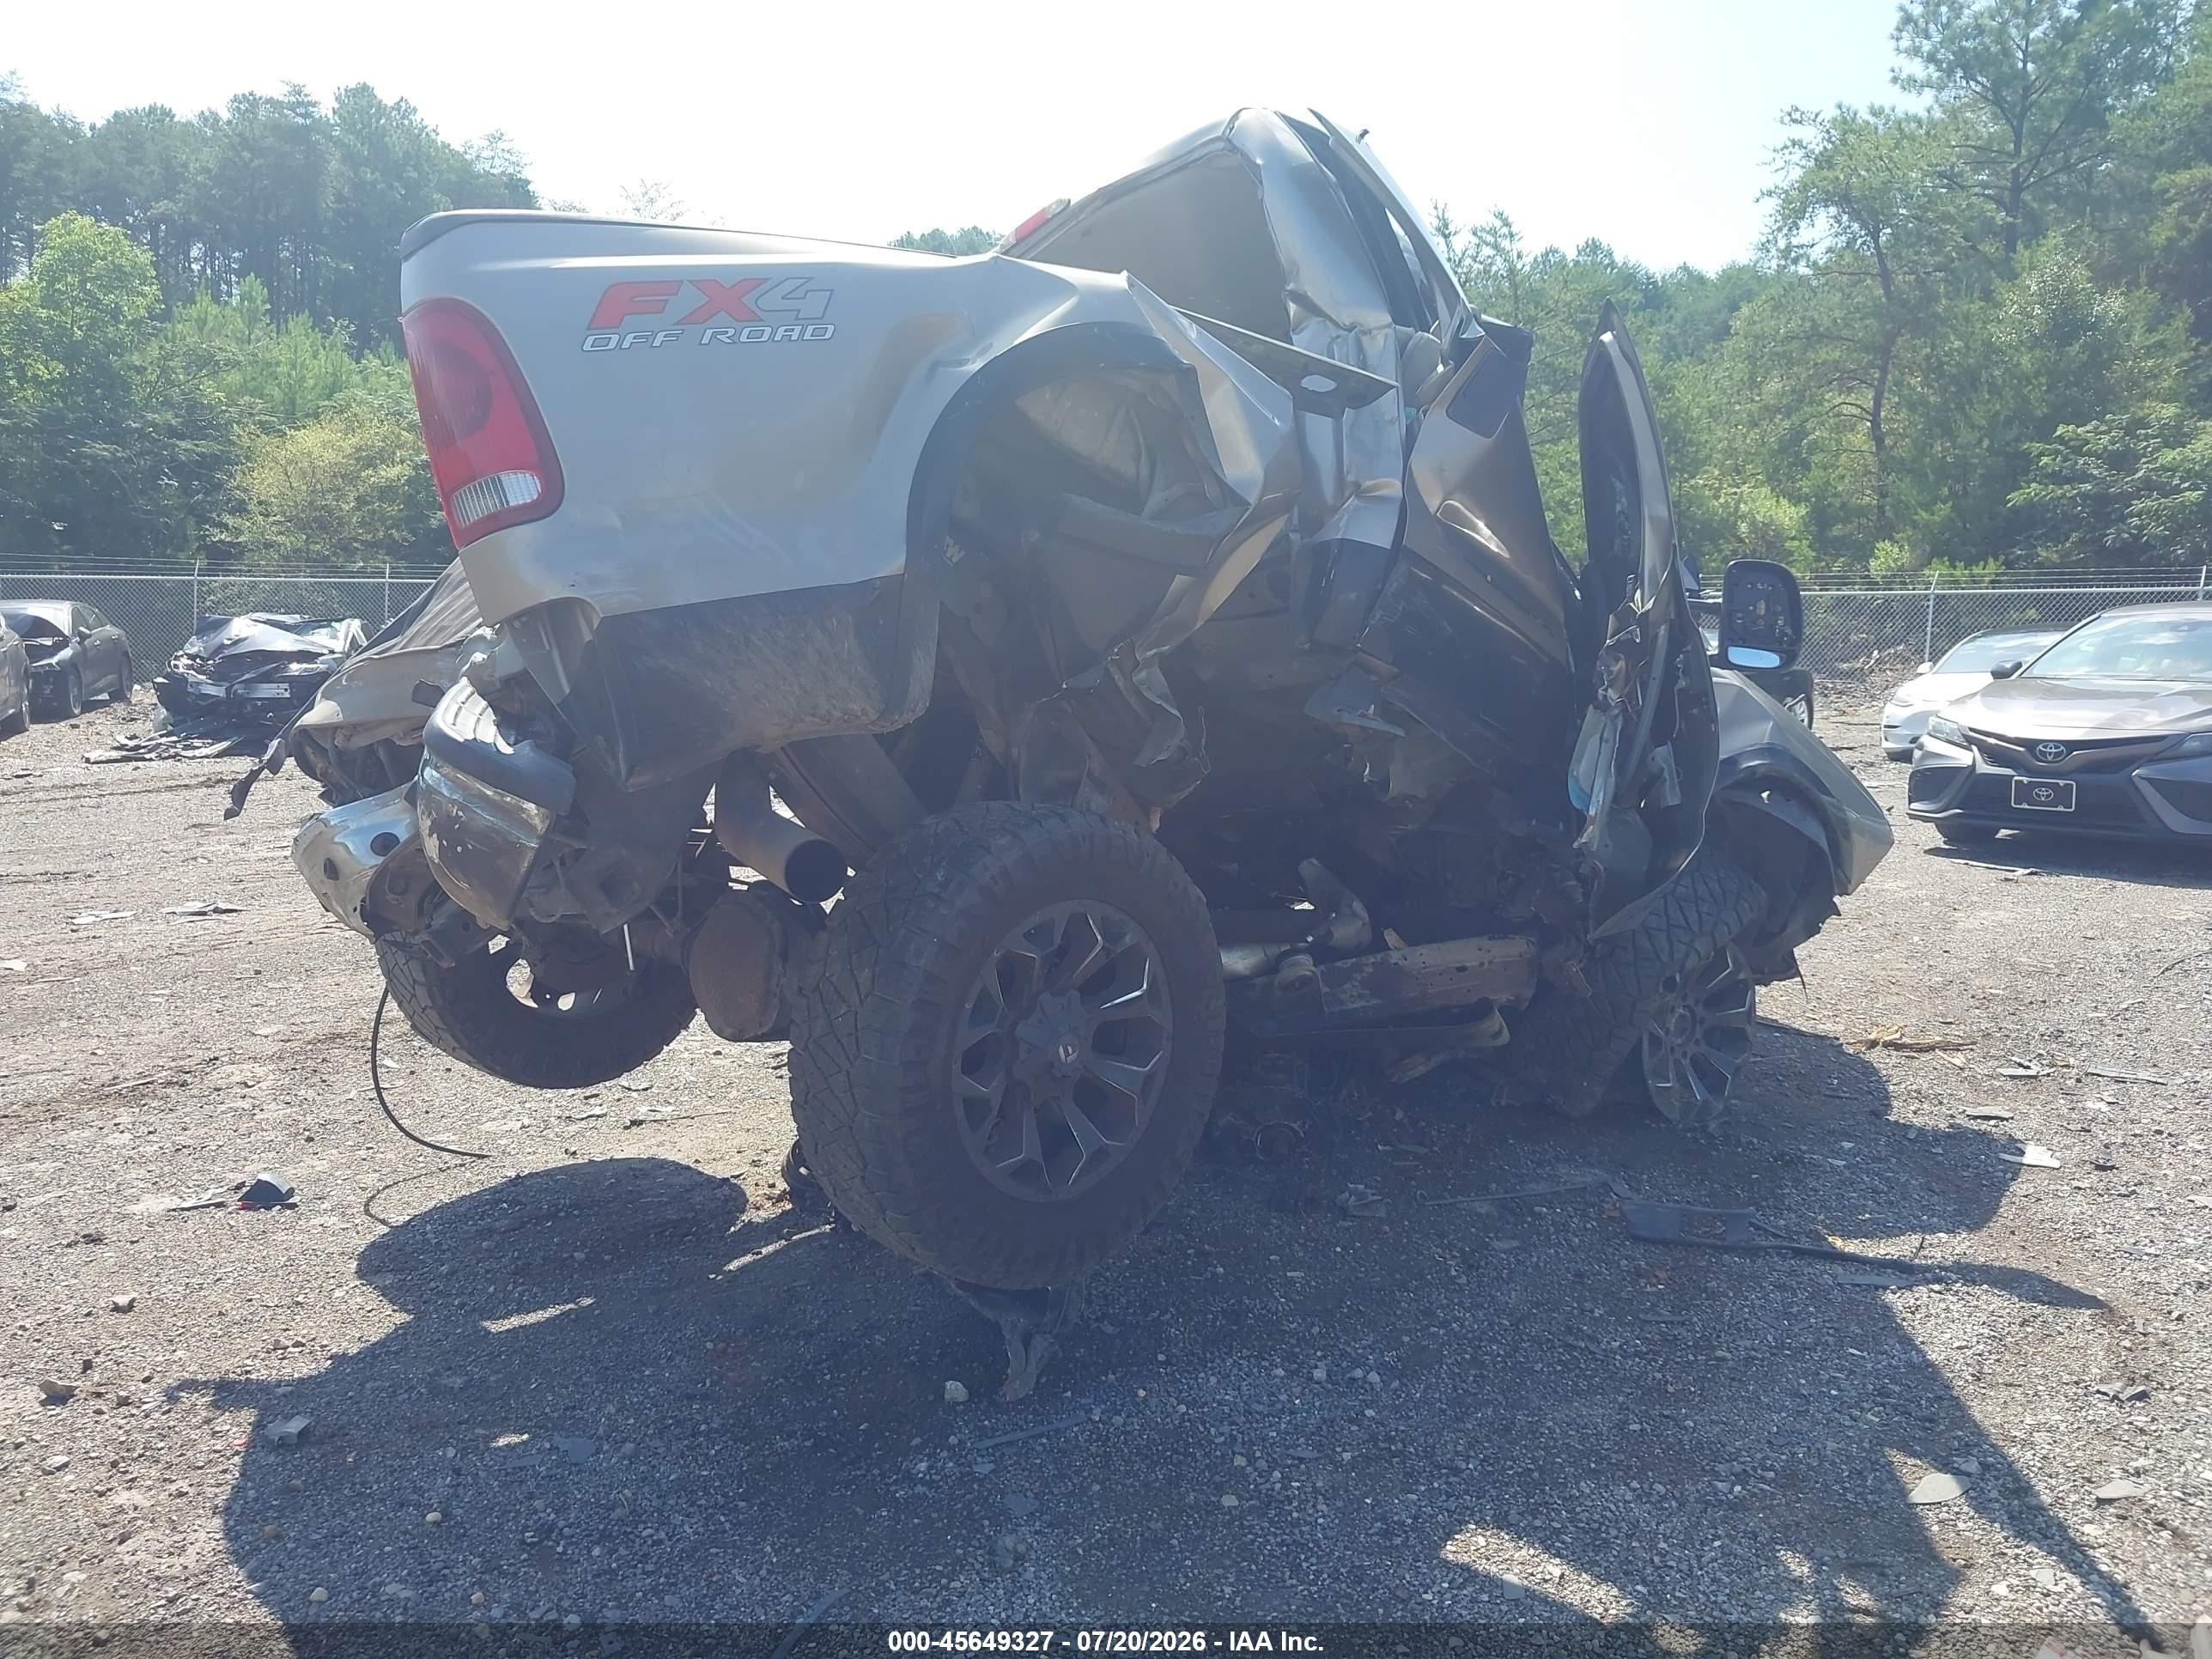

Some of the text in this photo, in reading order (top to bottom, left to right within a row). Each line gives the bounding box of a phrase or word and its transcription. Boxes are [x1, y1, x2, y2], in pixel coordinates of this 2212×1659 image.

[586, 276, 834, 331] FX4
[581, 324, 836, 352] OFF ROAD
